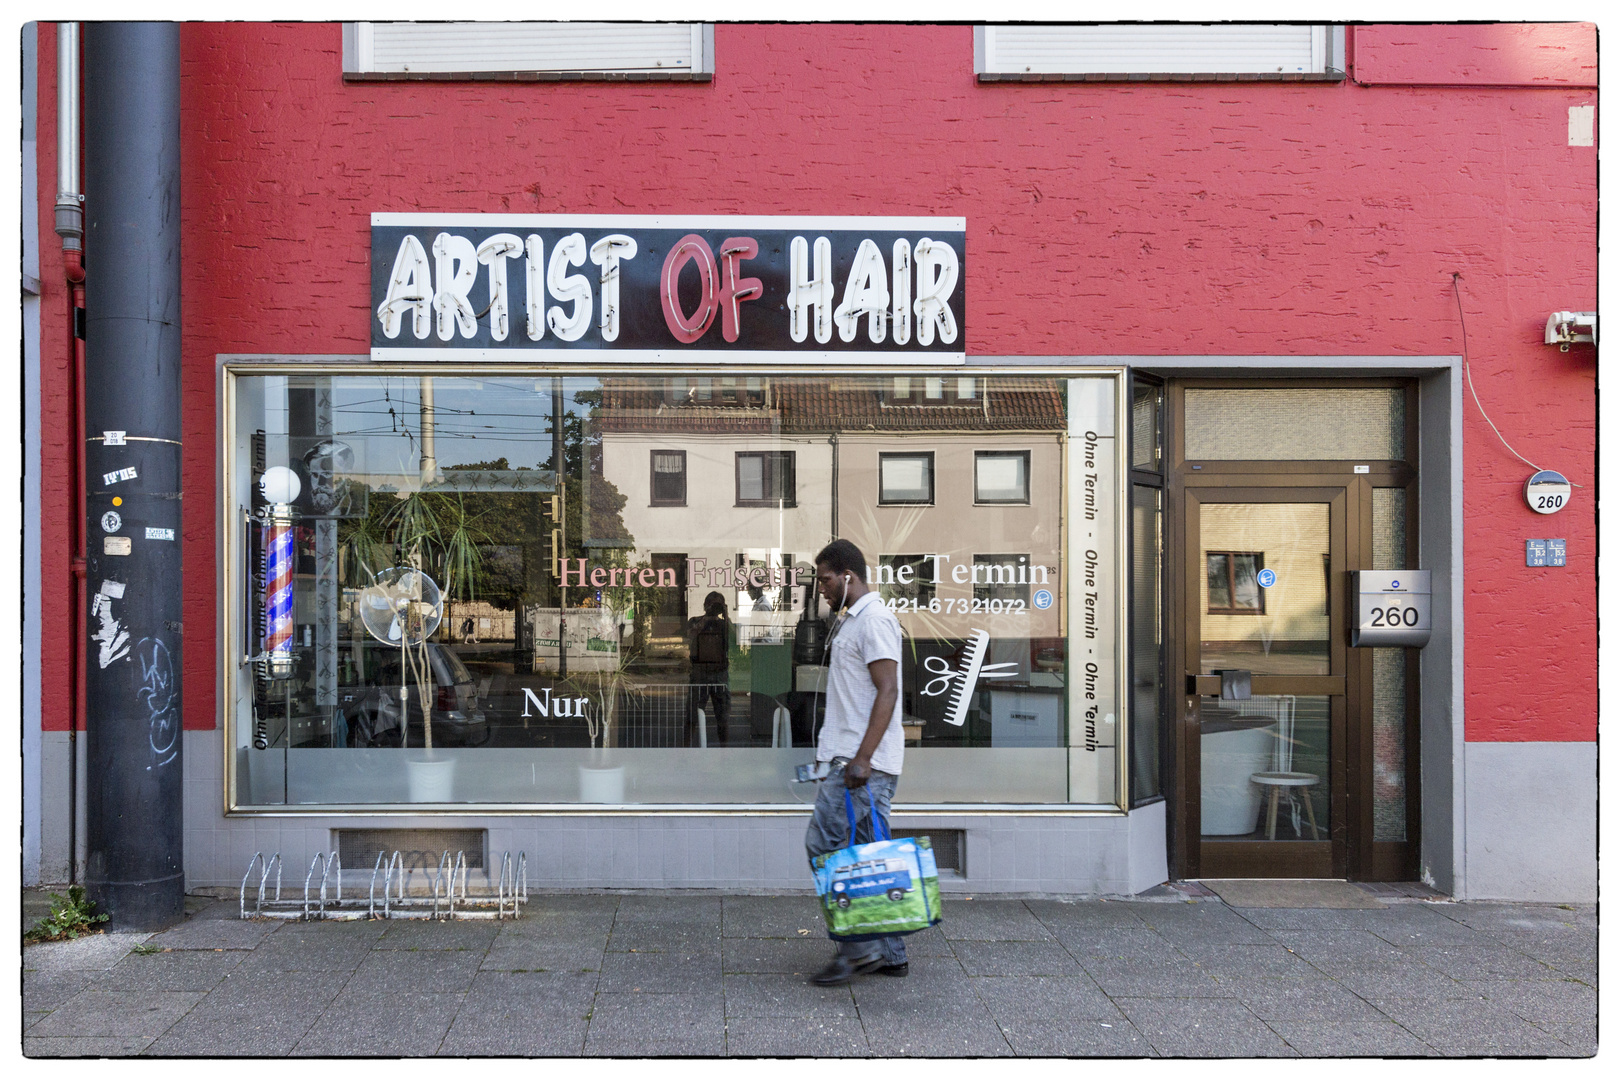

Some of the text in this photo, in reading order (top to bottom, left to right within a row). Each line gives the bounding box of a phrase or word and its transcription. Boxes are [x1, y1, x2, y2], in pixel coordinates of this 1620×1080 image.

[377, 232, 959, 346] ARTIST OF HAIR
[253, 428, 267, 476] Termin
[1085, 430, 1098, 468] Ohne
[1085, 473, 1098, 520] Termin
[1538, 495, 1563, 509] 260
[557, 557, 804, 588] Herren Friseur
[923, 554, 1050, 585] Termin
[1085, 549, 1098, 587] Ohne
[1085, 591, 1098, 639] Termin
[1370, 606, 1419, 627] 260
[1085, 662, 1098, 700] Ohne
[520, 687, 589, 719] Nur
[254, 714, 267, 750] Ohne
[1085, 705, 1098, 752] Termin
